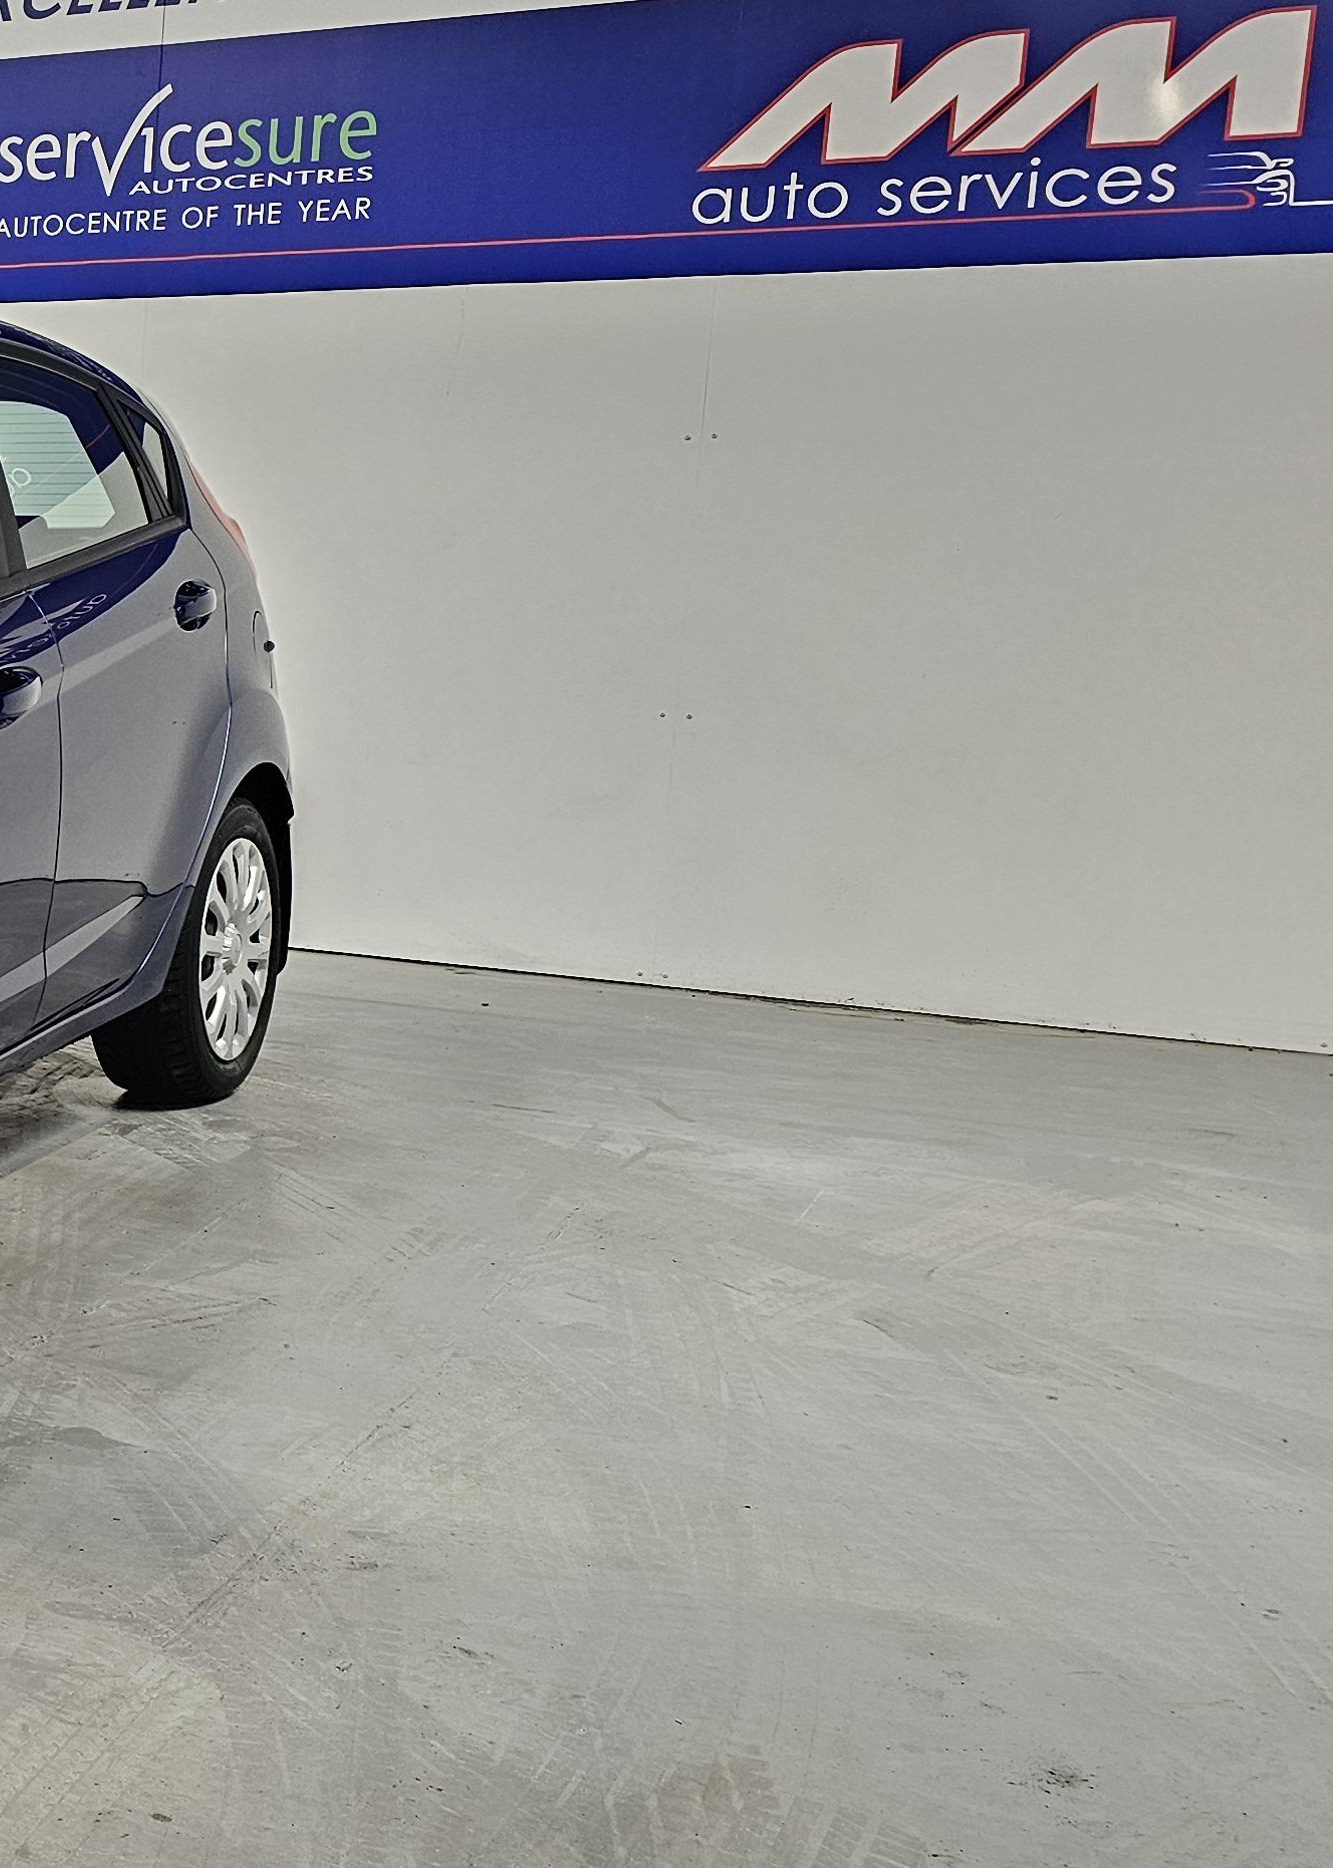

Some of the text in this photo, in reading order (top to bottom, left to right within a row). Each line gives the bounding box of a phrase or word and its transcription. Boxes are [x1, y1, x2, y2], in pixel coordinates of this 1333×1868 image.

[698, 5, 1317, 171] MM
[129, 166, 373, 196] AUTOCENTRES
[692, 157, 1177, 226] auto services
[181, 205, 220, 229] OF
[233, 203, 282, 226] THE
[298, 197, 372, 223] YEAR
